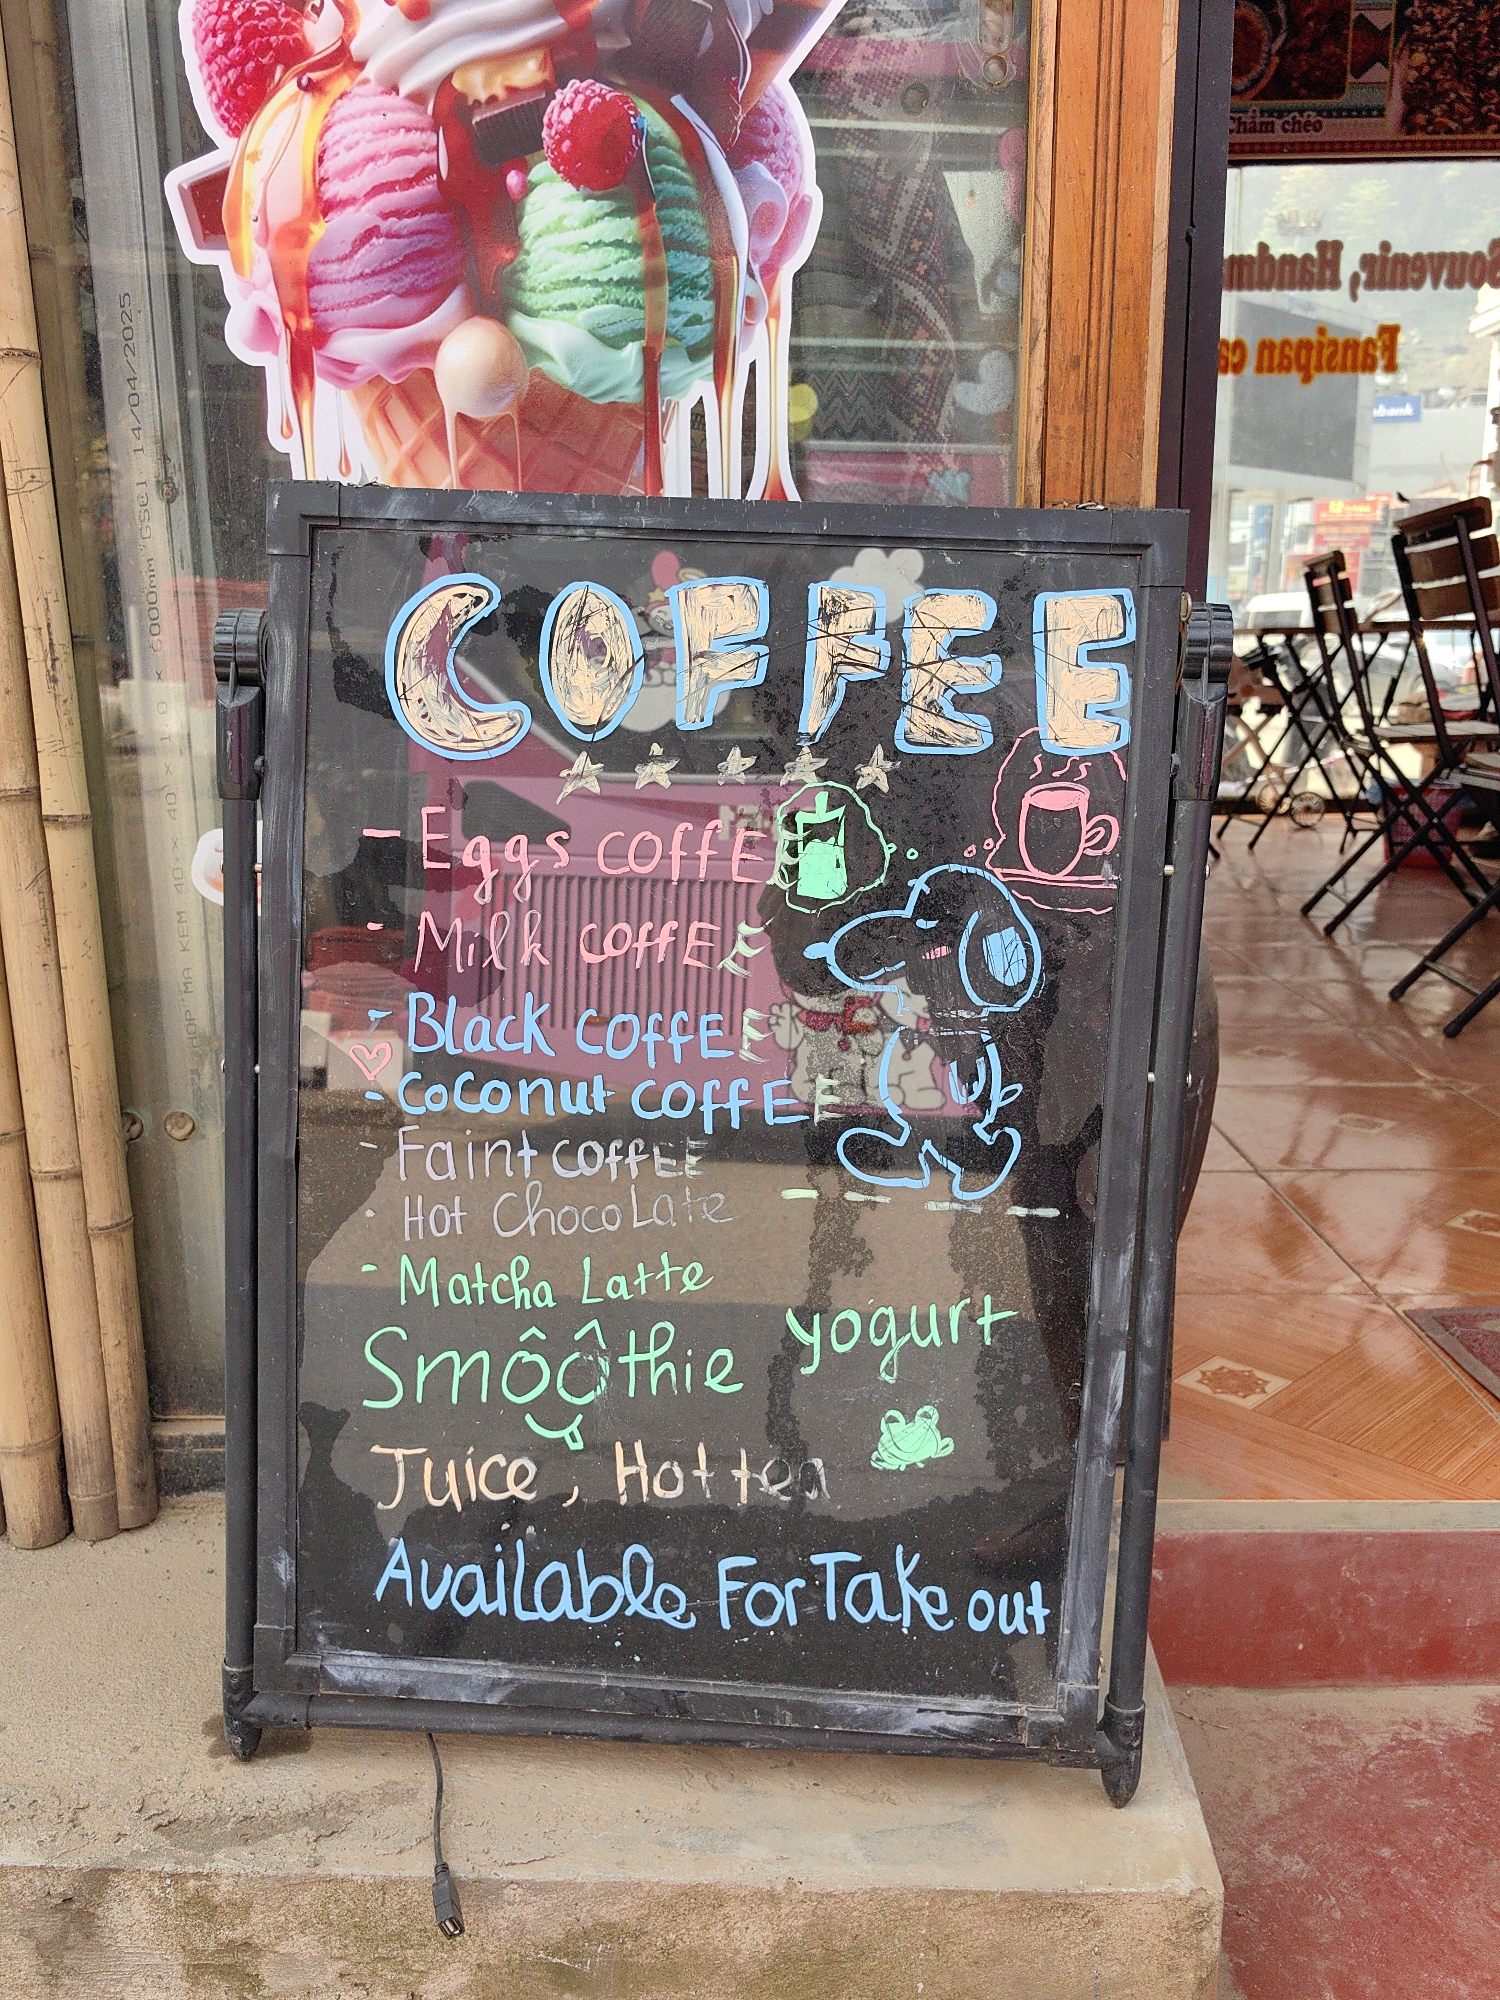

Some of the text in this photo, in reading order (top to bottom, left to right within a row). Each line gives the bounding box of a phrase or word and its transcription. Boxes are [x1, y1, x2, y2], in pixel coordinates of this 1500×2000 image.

[118, 292, 145, 456] 14/04/2025
[384, 572, 1137, 760] COFFEE
[167, 791, 178, 821] 40
[421, 806, 570, 904] Eggs
[177, 910, 191, 952] KEM
[414, 910, 549, 974] Milk
[182, 967, 193, 995] MA
[408, 992, 555, 1057] Black
[398, 1125, 538, 1182] Faint
[404, 1195, 467, 1241] Hot
[400, 1252, 714, 1310] Matcha Latte
[785, 1294, 1019, 1383] yogurt
[614, 1439, 714, 1505] Hot
[374, 1537, 1050, 1635] Available For Take out
